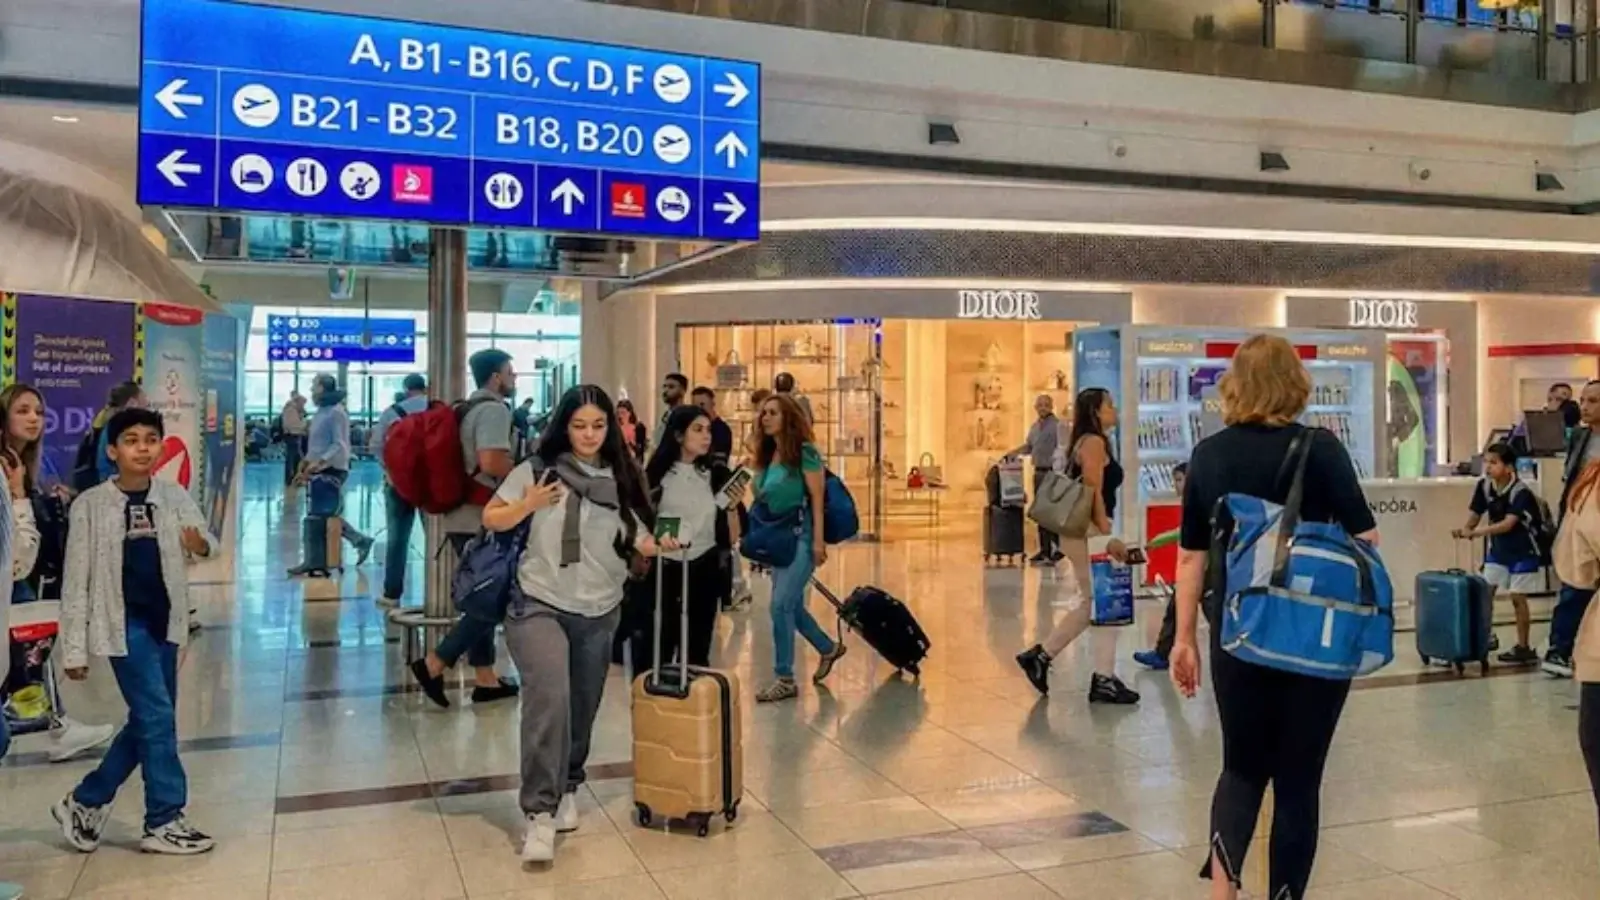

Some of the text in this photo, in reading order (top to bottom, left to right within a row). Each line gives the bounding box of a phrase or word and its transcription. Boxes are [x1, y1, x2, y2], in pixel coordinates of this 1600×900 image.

[350, 33, 392, 72] A,
[626, 64, 645, 94] F
[496, 112, 644, 157] B18, B20
[958, 289, 1042, 319] DIOR
[1348, 299, 1419, 328] DIOR
